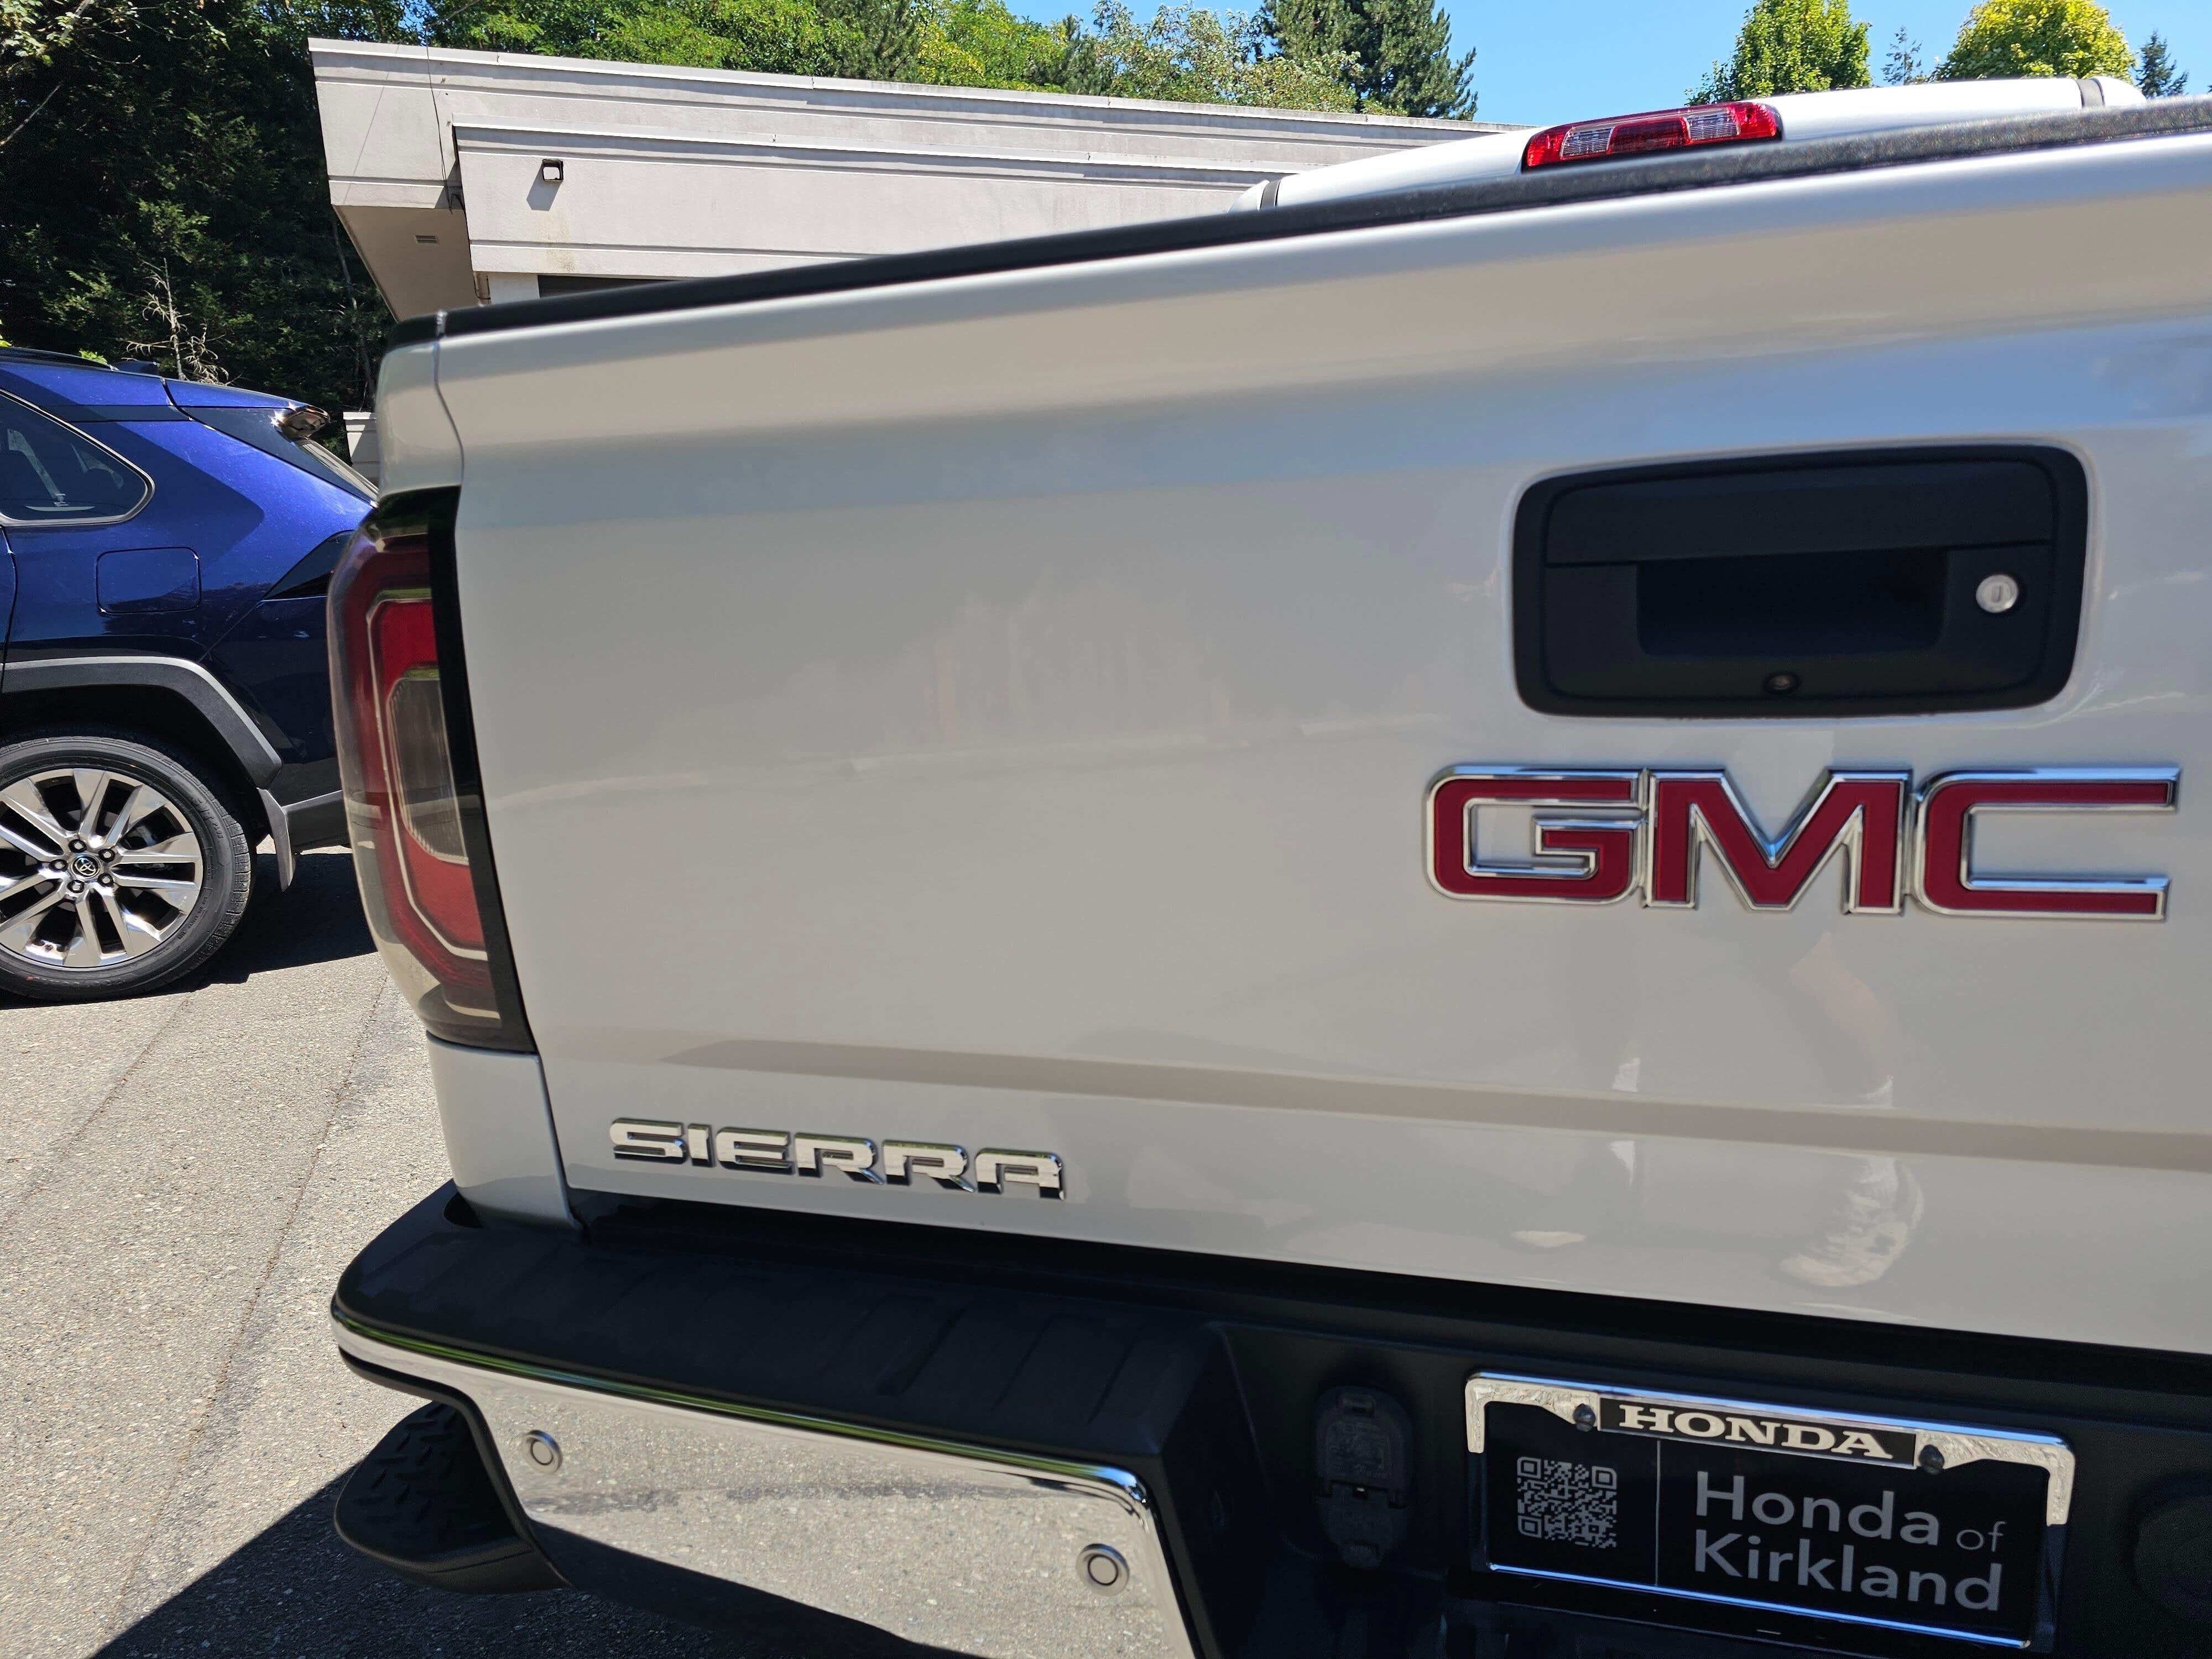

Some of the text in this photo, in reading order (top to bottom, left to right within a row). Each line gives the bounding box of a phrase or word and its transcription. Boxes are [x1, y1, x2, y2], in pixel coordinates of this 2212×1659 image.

[1426, 766, 2179, 919] GMC
[609, 1117, 1066, 1201] SIERRA
[1619, 1404, 1893, 1460] HONDA
[1695, 1470, 2006, 1552] Honda of
[1694, 1528, 2003, 1612] Kirkland
